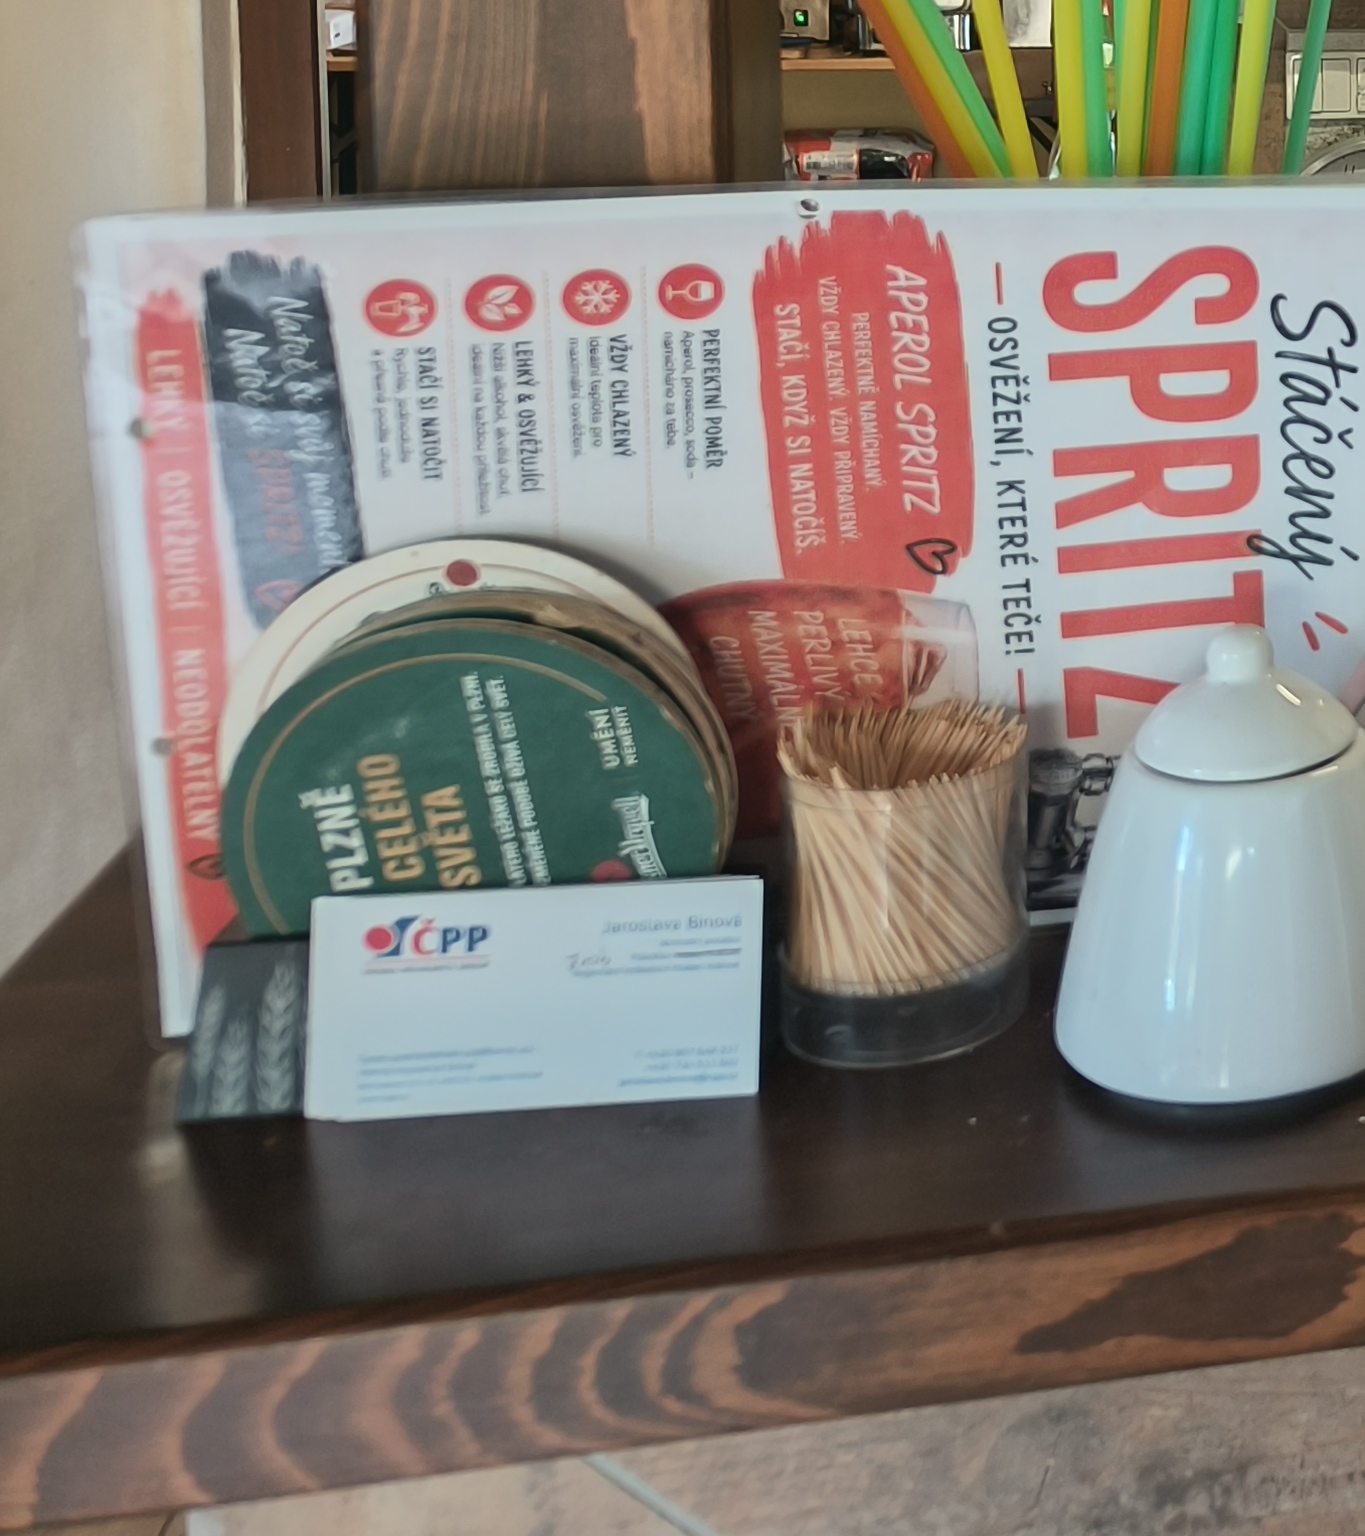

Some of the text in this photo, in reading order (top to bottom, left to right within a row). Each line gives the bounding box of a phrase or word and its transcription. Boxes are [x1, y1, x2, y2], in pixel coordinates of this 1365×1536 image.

[266, 295, 319, 373] Natoč
[609, 333, 637, 457] VŽDY CHLAZENÝ
[885, 264, 942, 515] APEROL SPRITZ
[418, 346, 447, 480] STAČÍ SI NATOČIT
[515, 340, 546, 492] LEHKÝ & OSVĚŽUJÍCÍ
[703, 328, 728, 469] PERFEKTNÍ POMĚR
[774, 302, 827, 556] STAČÍ, KDYŽ SI NATOČÍŠ.
[819, 275, 864, 546] VŽDY CHLAZENÝ. VŽDY PŘIPRAVENÝ.
[852, 311, 887, 494] PERFEKTNĚ NAMÍCHANÝ.
[1247, 292, 1360, 582] Stáčený
[987, 316, 1042, 657] OSVĚŽENÍ, KTERÉ TEČE!
[709, 635, 760, 720] CHUTNÝ
[792, 610, 852, 702] PERLIVÝ
[837, 617, 884, 685] LEHCE
[584, 708, 621, 770] UMĚNÍ
[611, 705, 639, 766] NEMĚNIT
[298, 783, 375, 894] PLZNĚ
[357, 753, 426, 883] CELÉHO
[419, 784, 482, 890] SVĚTA
[412, 917, 490, 957] ČPP
